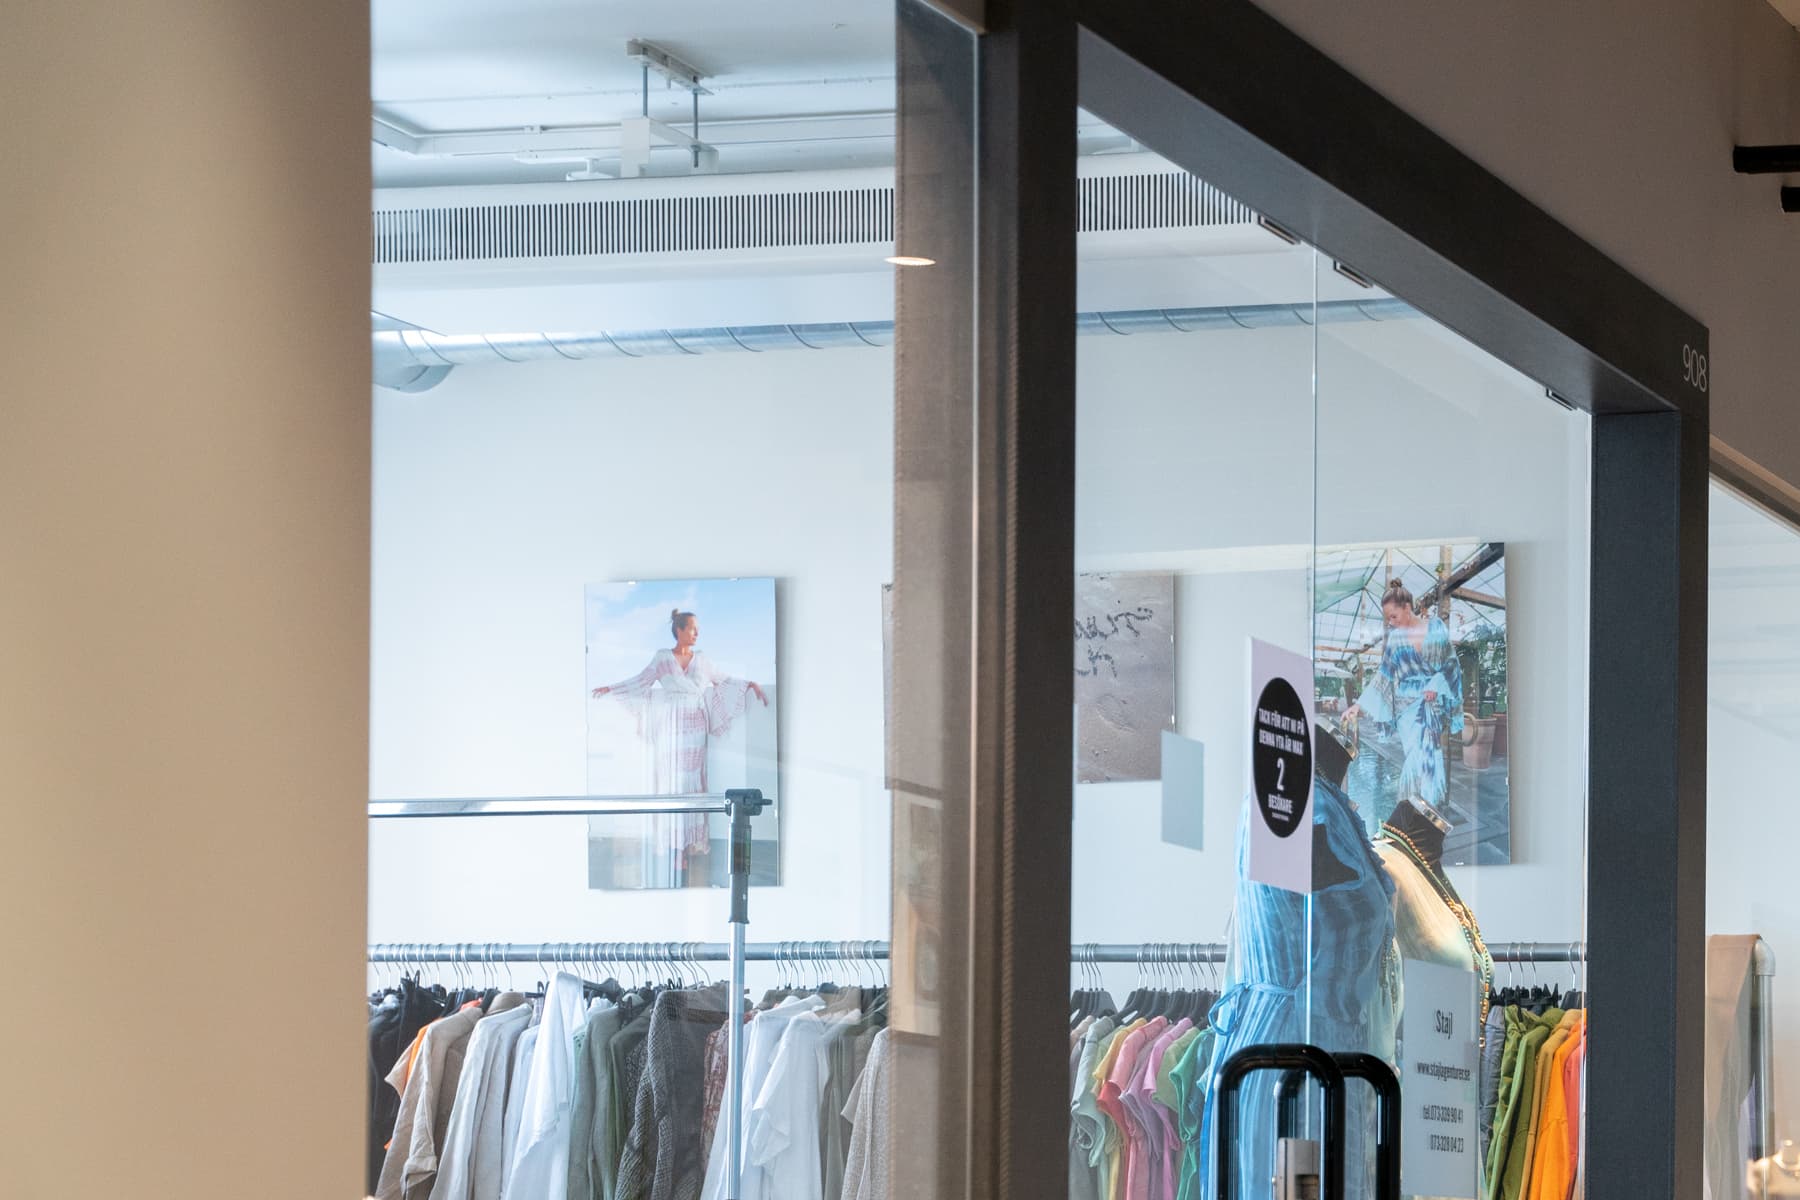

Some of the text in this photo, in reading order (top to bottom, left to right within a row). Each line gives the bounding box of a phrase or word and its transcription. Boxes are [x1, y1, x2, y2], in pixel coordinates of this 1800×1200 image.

[1682, 343, 1707, 393] 908
[1258, 708, 1270, 725] TACK
[1271, 710, 1281, 728] FÖR
[1281, 716, 1290, 731] ATT
[1297, 718, 1305, 735] PÅ
[1259, 729, 1304, 756] DENNA YTA ÄR MAX
[1276, 757, 1285, 791] 2
[1268, 794, 1293, 814] BESÖKARE
[1435, 1009, 1453, 1040] Stajl
